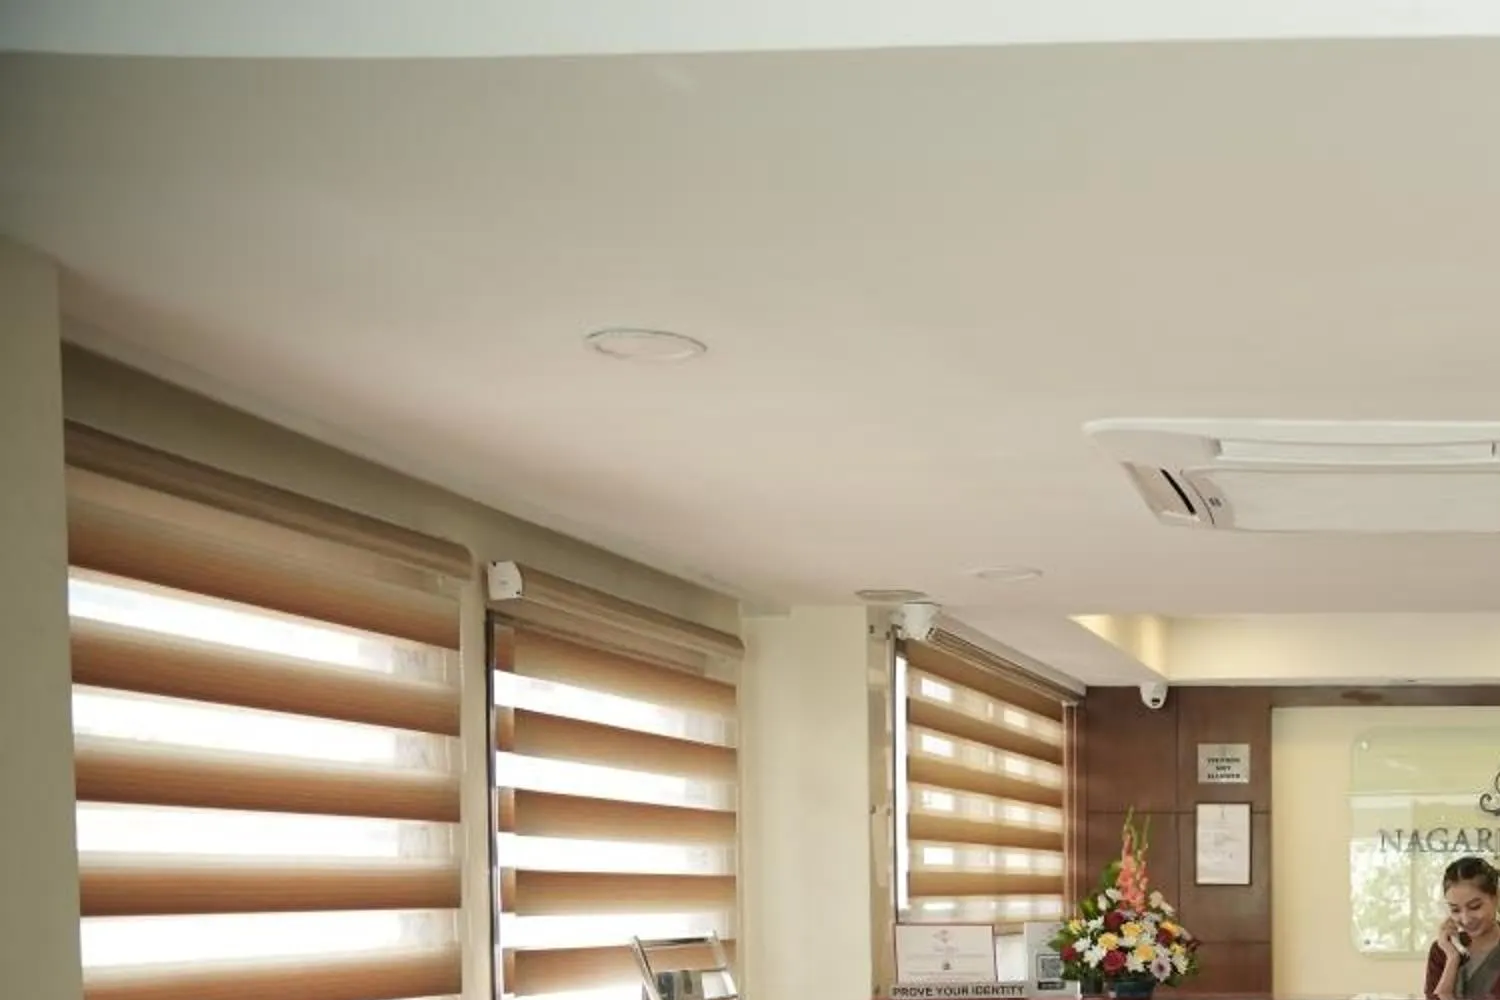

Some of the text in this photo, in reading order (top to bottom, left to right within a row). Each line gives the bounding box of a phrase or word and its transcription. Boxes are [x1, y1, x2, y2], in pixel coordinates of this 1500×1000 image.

[893, 985, 933, 997] PROVE
[936, 985, 969, 997] YOUR
[972, 984, 1025, 997] IDENTITY
